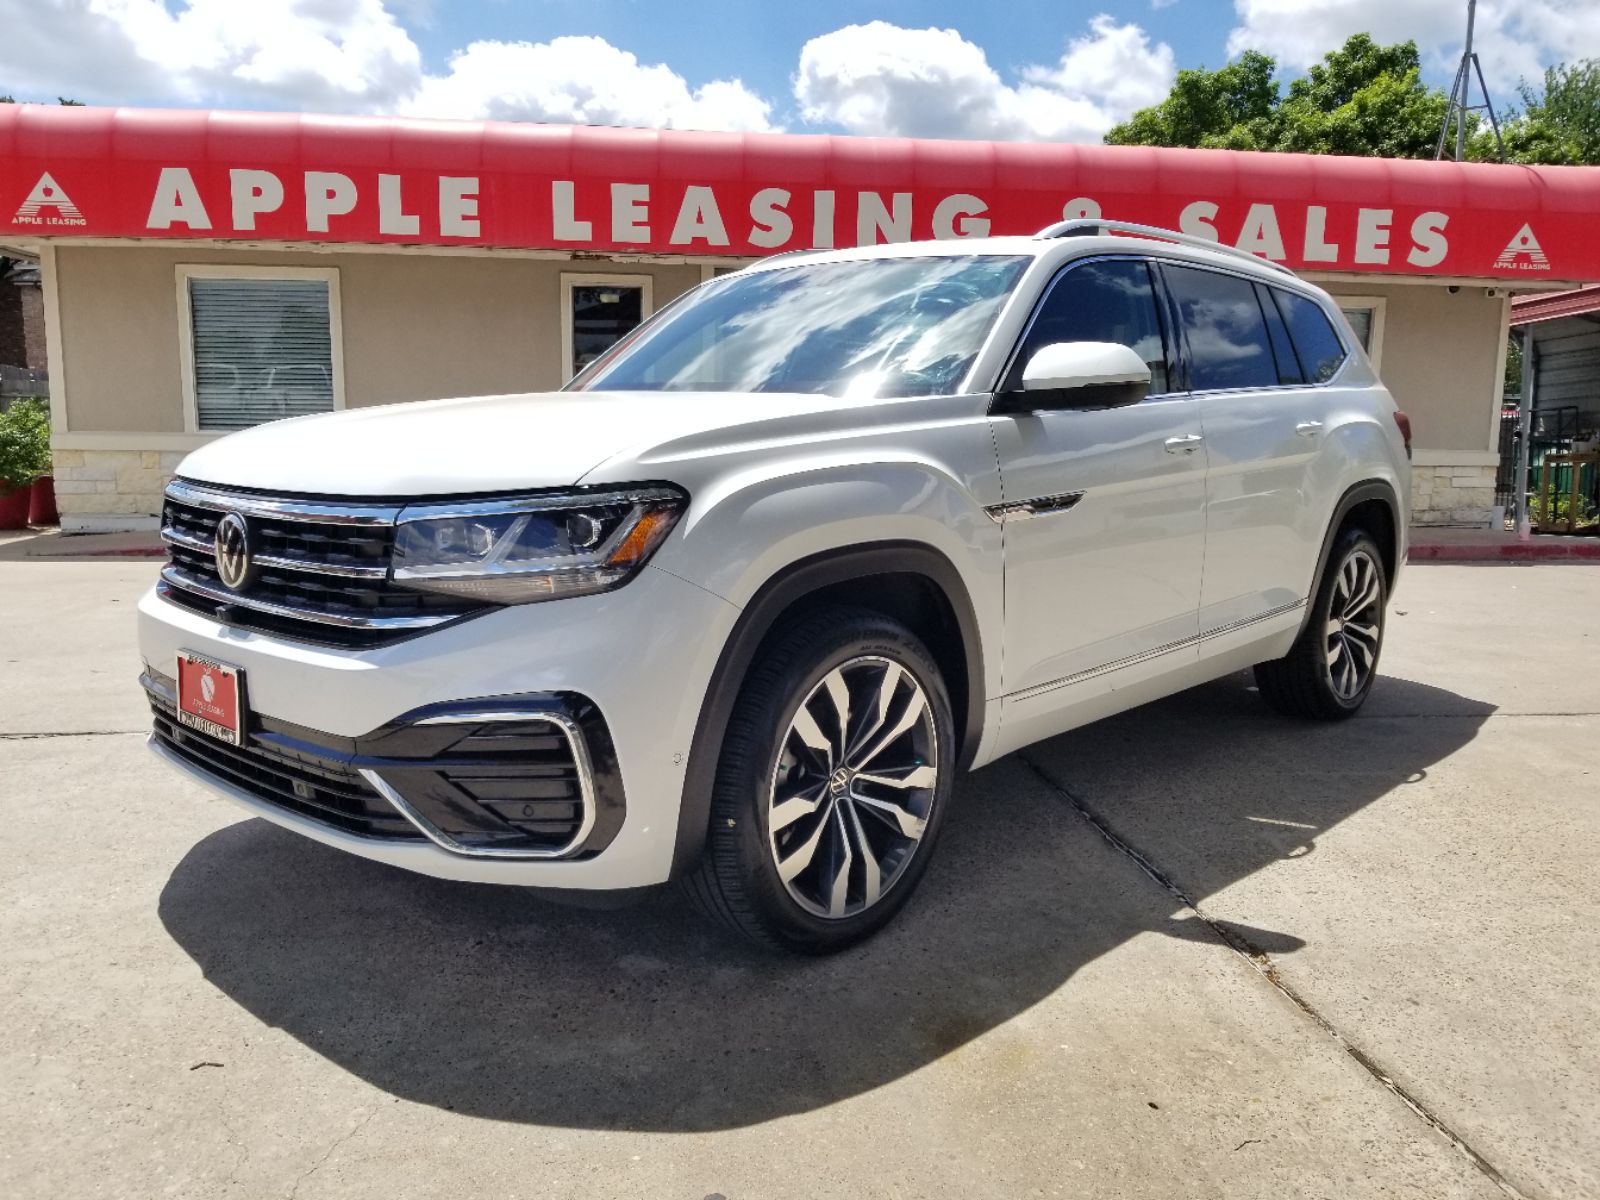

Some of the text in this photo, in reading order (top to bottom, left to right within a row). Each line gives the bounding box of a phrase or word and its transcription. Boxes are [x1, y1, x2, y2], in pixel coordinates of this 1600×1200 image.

[11, 216, 87, 226] APPLE LEASING
[146, 167, 481, 238] APPLE
[551, 180, 992, 249] LEASING
[1178, 200, 1450, 268] SALES
[1493, 261, 1551, 270] APPLE LEASING
